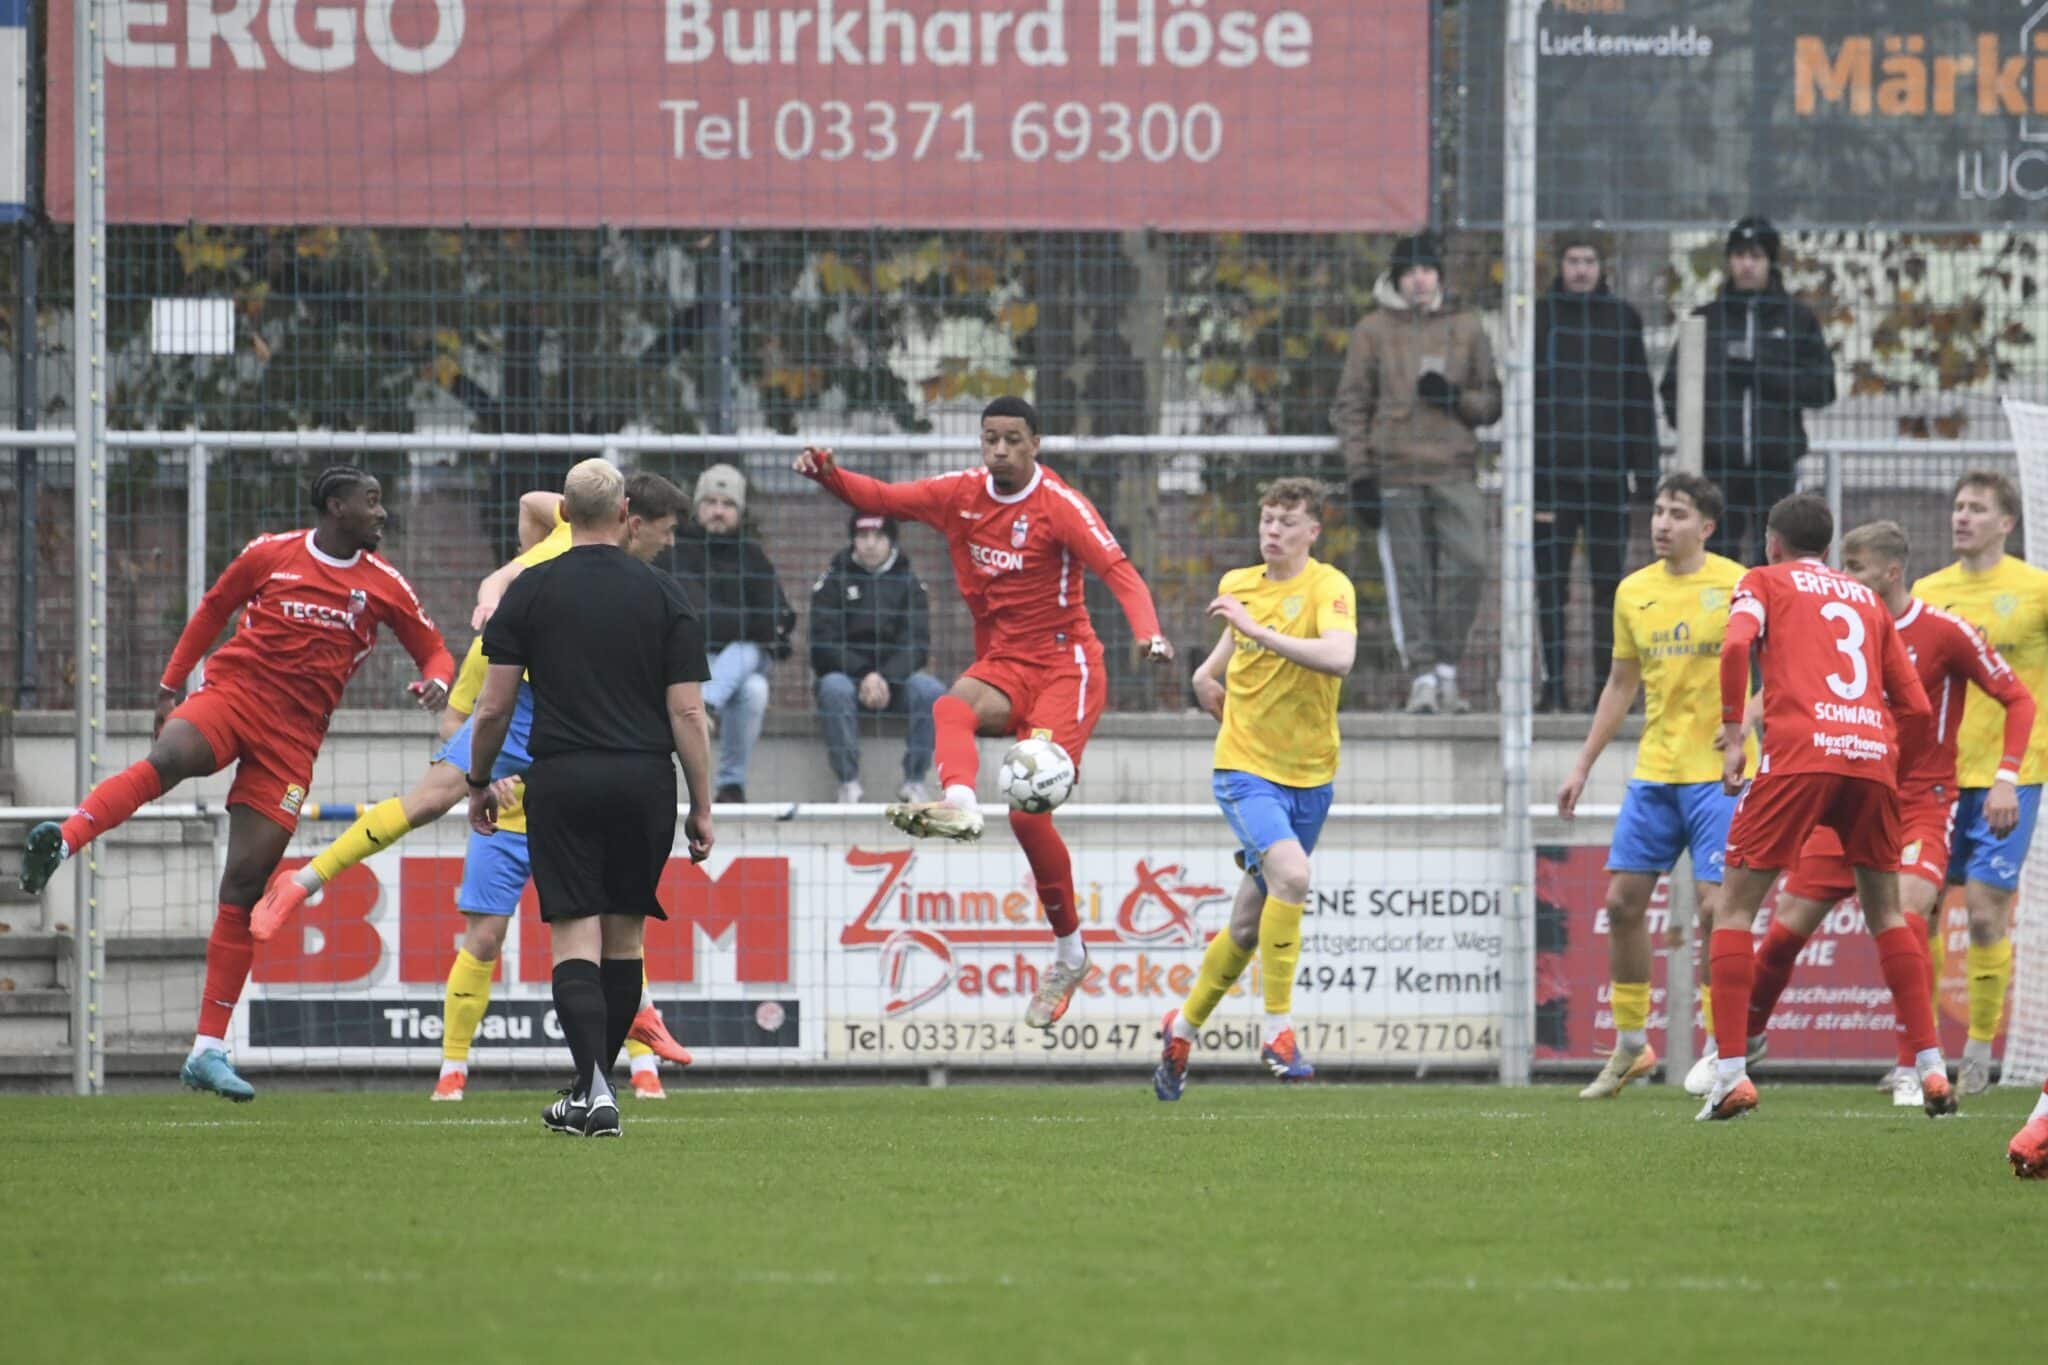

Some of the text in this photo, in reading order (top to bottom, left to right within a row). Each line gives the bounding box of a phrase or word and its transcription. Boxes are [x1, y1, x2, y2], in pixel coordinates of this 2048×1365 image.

[102, 0, 465, 73] ERGO
[664, 0, 1313, 67] Burkhard Höse
[1540, 25, 1713, 56] Luckenwalde
[1795, 32, 2048, 116] Märki
[660, 100, 1223, 162] Tel 03371 69300
[1957, 150, 2048, 200] LUC
[1790, 570, 1876, 608] ERFURT
[1820, 601, 1868, 700] 3
[1814, 701, 1884, 730] SCHWARZ
[1302, 883, 1356, 916] ENÉ
[1300, 932, 1503, 958] ettgendorfer Weg
[1295, 966, 1378, 993] 4947
[1780, 984, 1893, 1009] aschanlage
[384, 1008, 532, 1039] Tieau
[845, 1025, 894, 1050] Tel.
[902, 1025, 1016, 1050] 033734
[1041, 1026, 1099, 1050] 500
[1106, 1025, 1141, 1050] 47
[1195, 1023, 1260, 1050] obil
[1299, 1025, 1347, 1050] 171
[1767, 1012, 1811, 1031] eder
